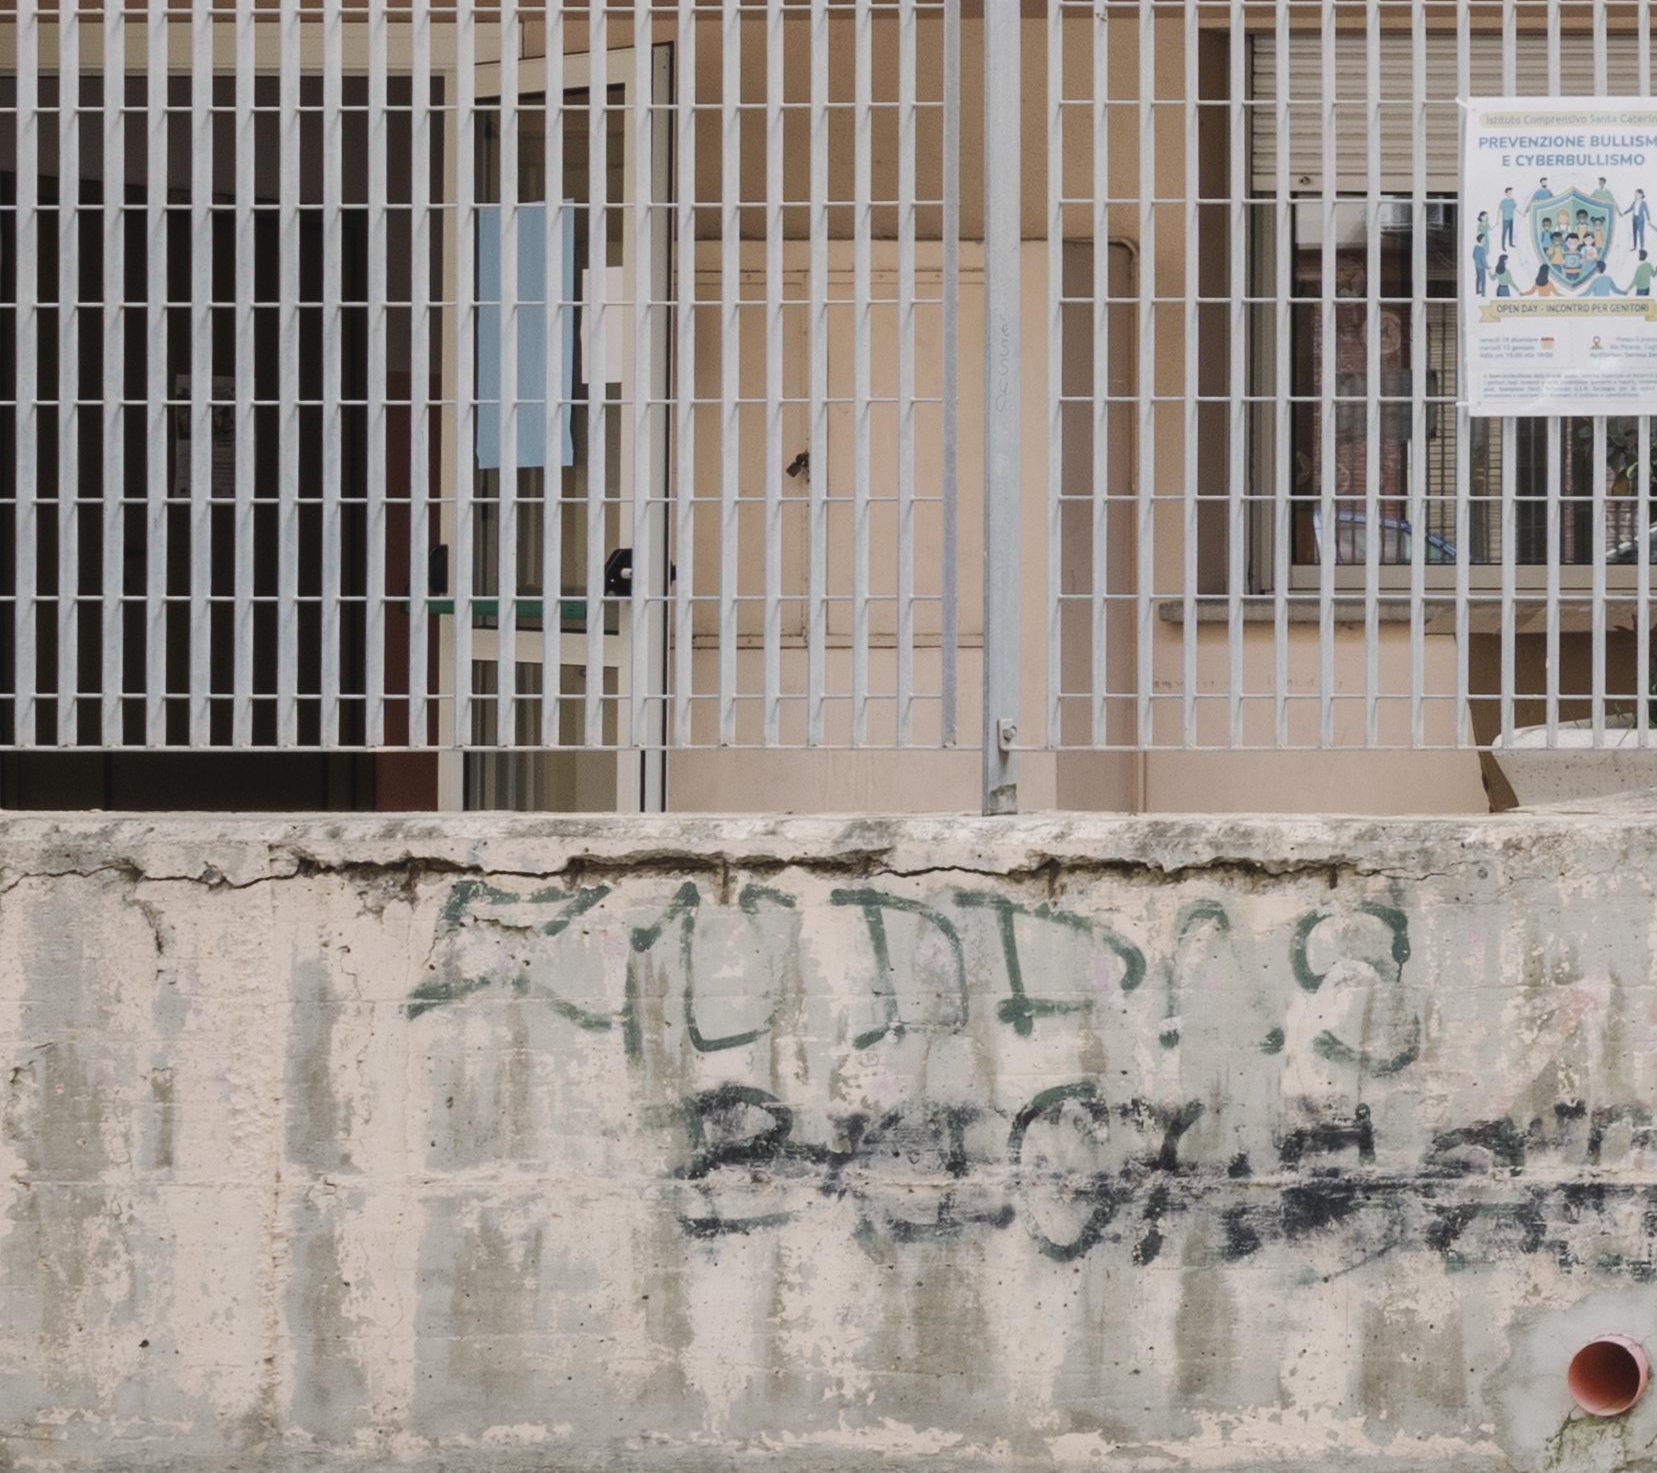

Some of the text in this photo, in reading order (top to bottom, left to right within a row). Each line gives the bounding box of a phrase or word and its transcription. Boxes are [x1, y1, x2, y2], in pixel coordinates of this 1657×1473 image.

[1486, 115, 1521, 125] Istituto
[1523, 114, 1588, 126] Comprensivo
[1589, 114, 1617, 124] Santa
[1478, 136, 1586, 148] PREVENZIONE
[1502, 154, 1646, 166] E CYBERBULLISMO
[1496, 303, 1649, 313] OPEN DAY INCONTRO PER GENITORI
